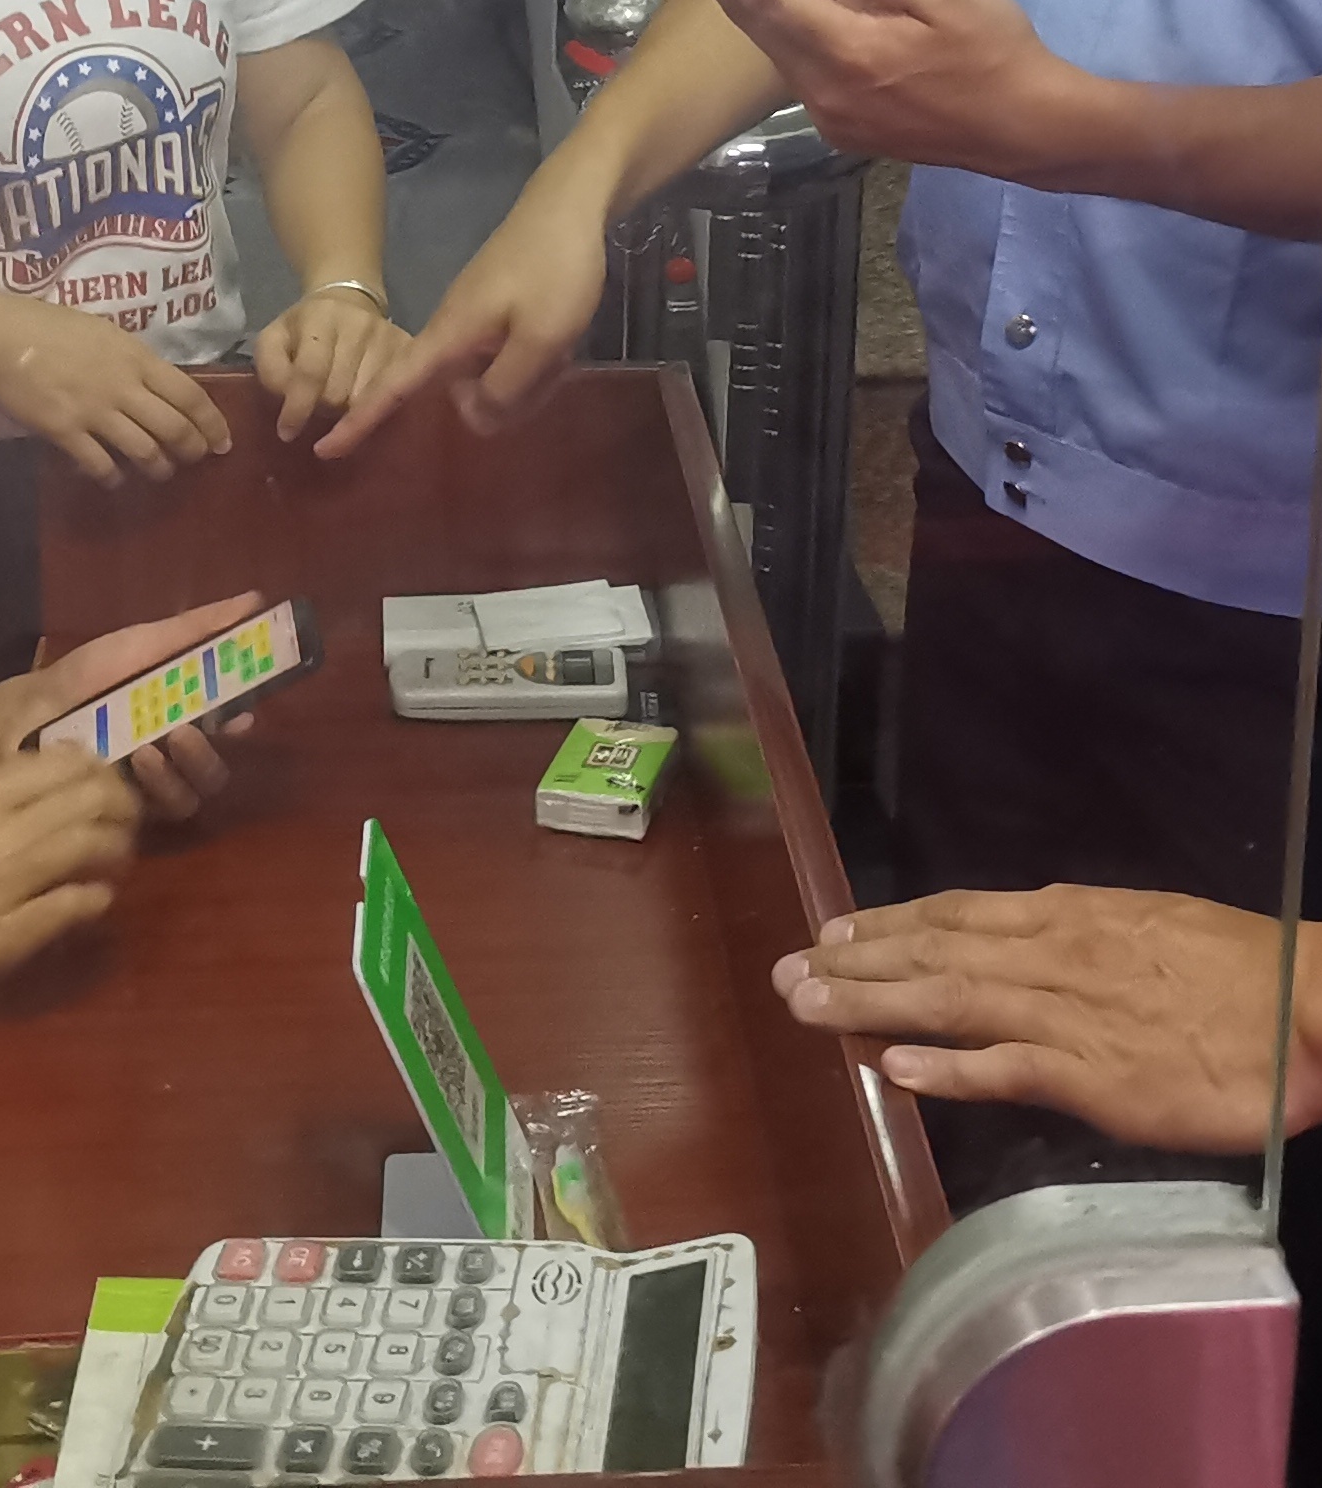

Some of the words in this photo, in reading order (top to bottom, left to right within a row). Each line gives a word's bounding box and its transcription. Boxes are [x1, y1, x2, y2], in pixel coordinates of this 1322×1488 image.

[337, 1297, 358, 1307] 4
[398, 1299, 419, 1309] 7
[261, 1341, 282, 1351] 2
[388, 1345, 407, 1355] 8
